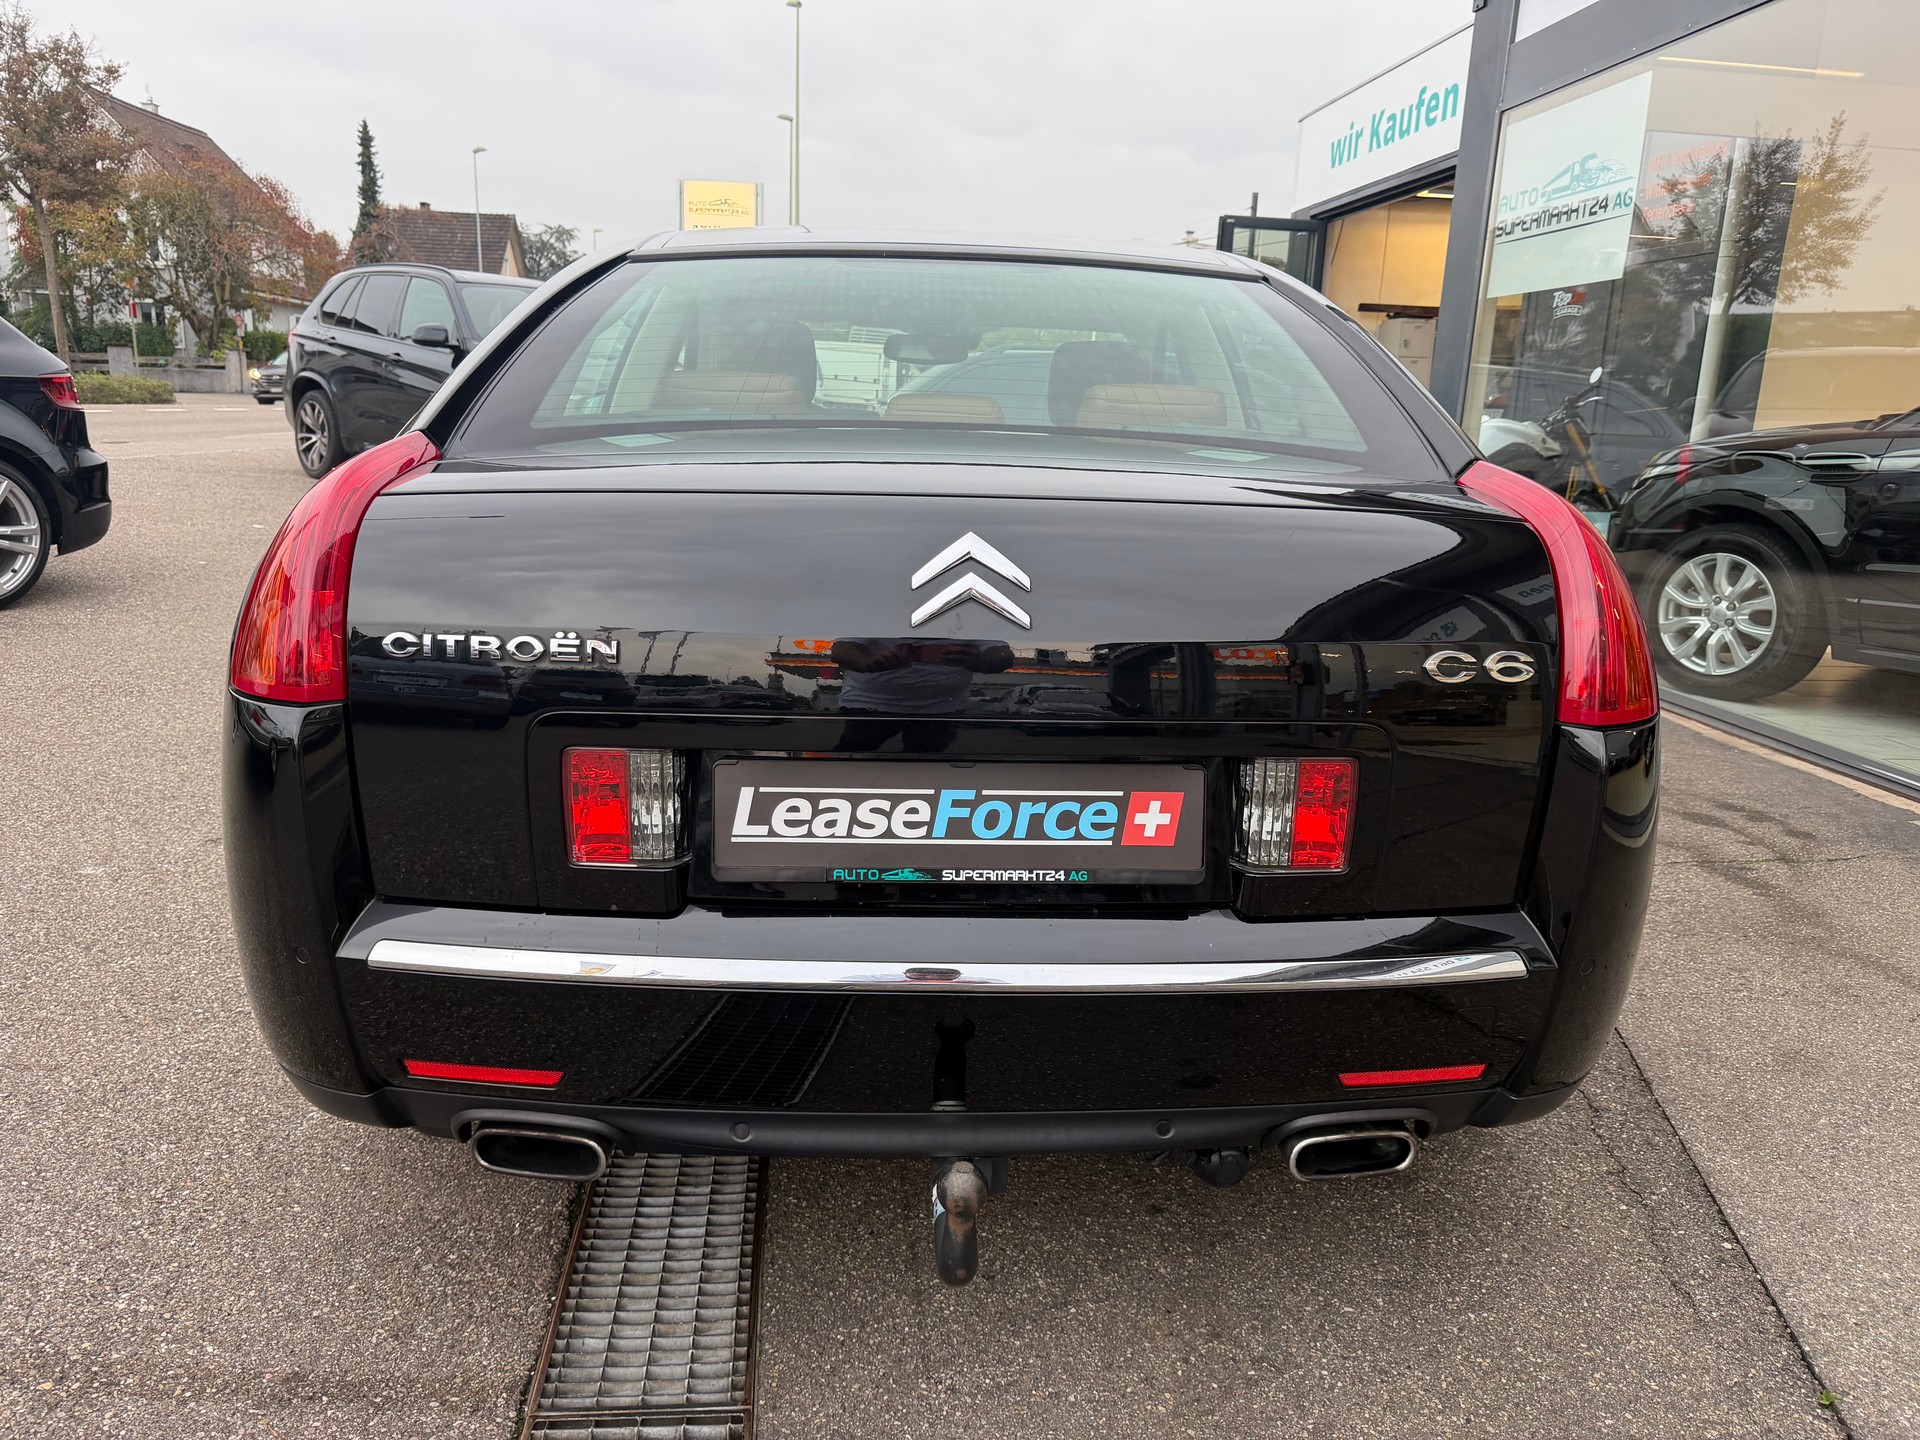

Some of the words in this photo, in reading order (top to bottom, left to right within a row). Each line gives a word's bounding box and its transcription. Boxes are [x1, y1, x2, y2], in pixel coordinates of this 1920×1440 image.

[1330, 121, 1365, 169] wir
[1368, 83, 1460, 153] Kaufen
[1494, 193, 1610, 239] SUPERMARKT24
[1612, 187, 1635, 211] AG
[1498, 187, 1539, 214] AUTO
[381, 631, 618, 664] CITROËN
[1422, 650, 1536, 684] C6
[731, 787, 1118, 839] LeaseForce
[833, 868, 879, 880] AUTO
[941, 870, 1066, 881] SUPERMARKT24
[1068, 871, 1088, 881] AG
